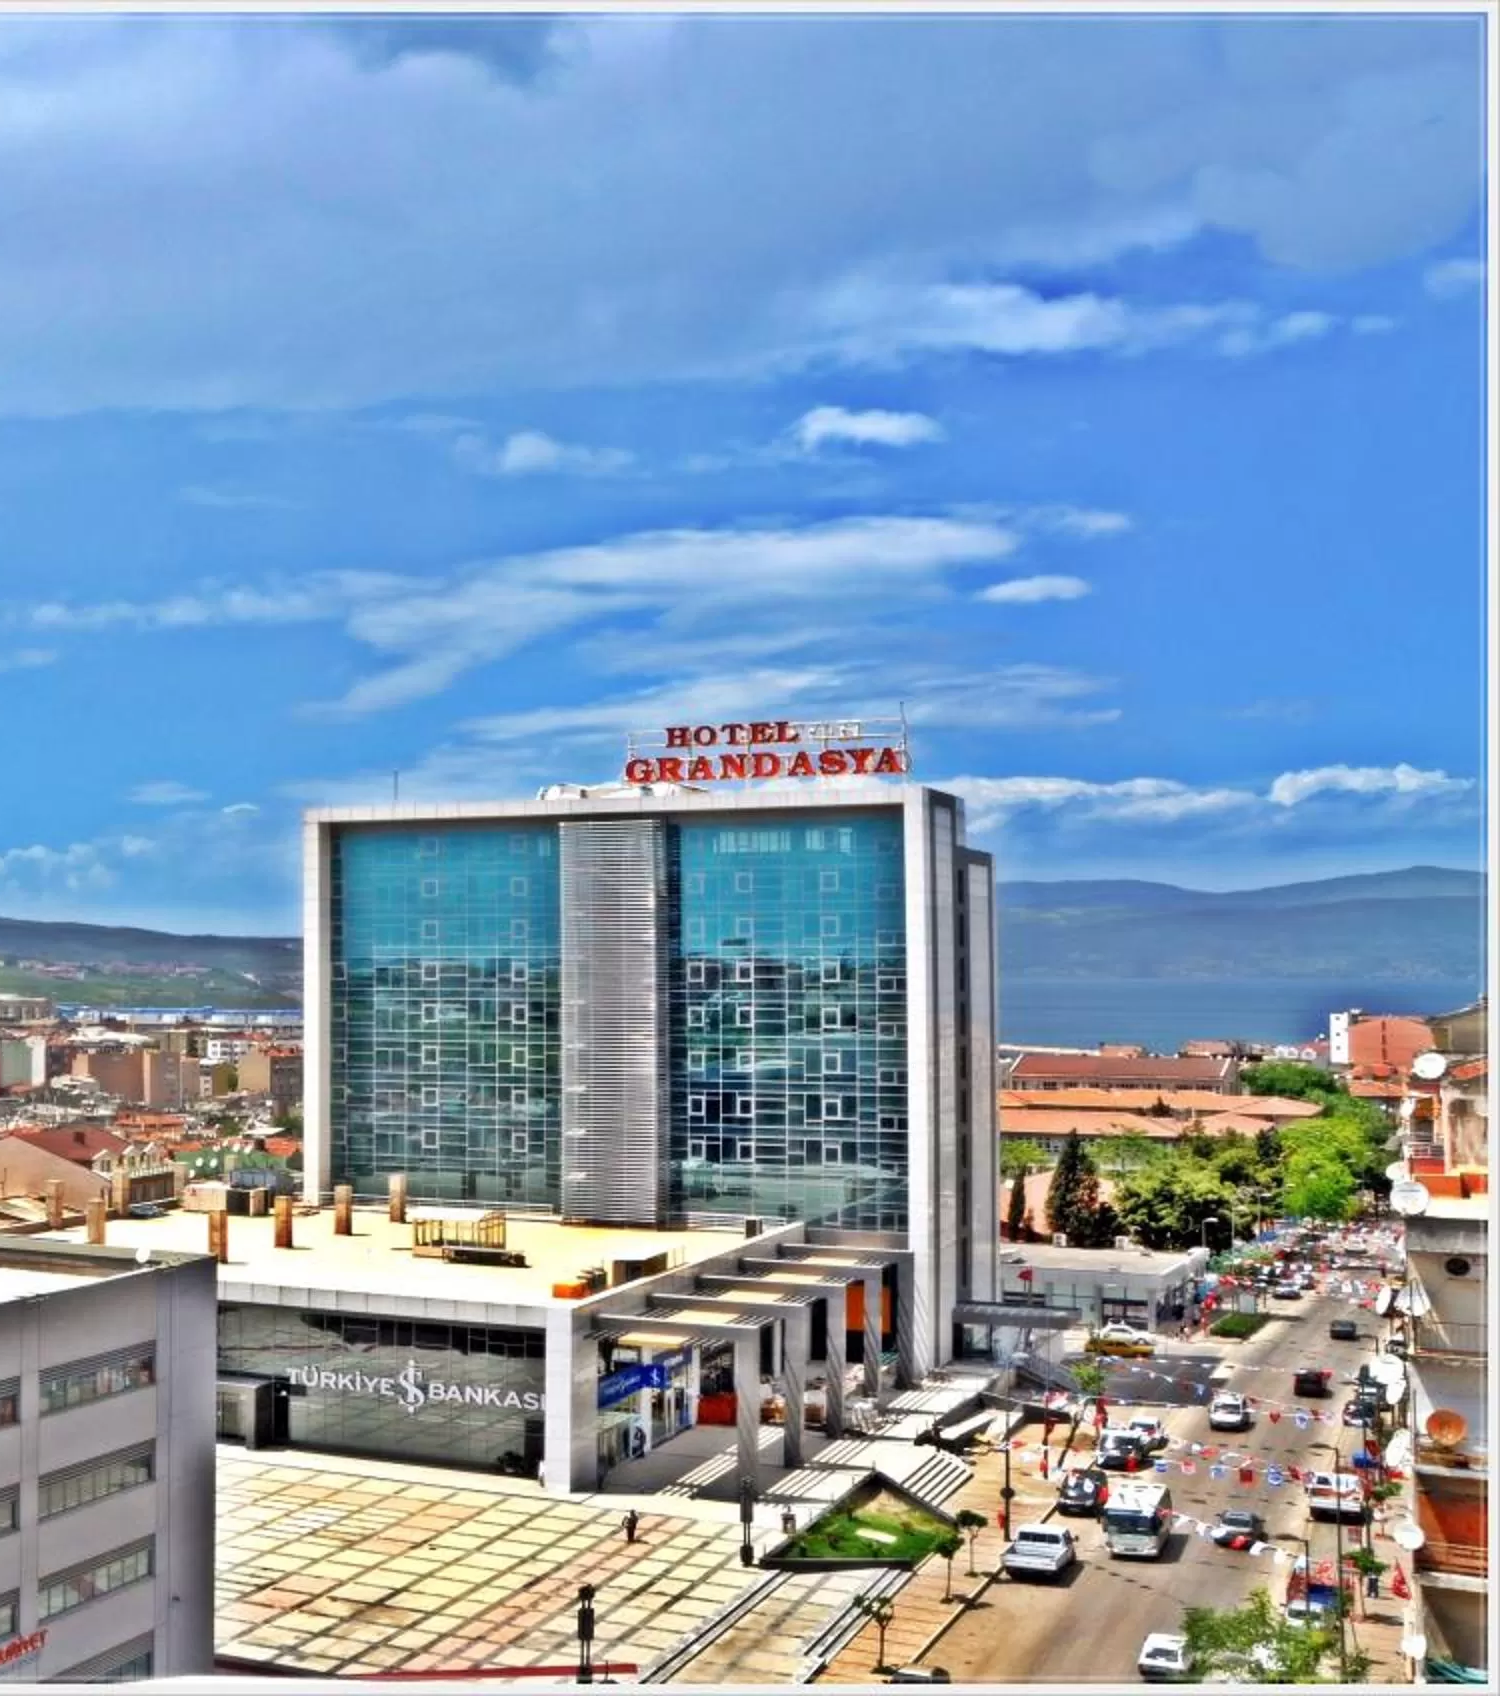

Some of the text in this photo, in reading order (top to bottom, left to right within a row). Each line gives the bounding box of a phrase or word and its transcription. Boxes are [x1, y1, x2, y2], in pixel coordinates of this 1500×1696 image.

[665, 721, 800, 749] HOTEL
[285, 1365, 395, 1396] TÜRKİYE
[428, 1382, 547, 1411] BANKASI
